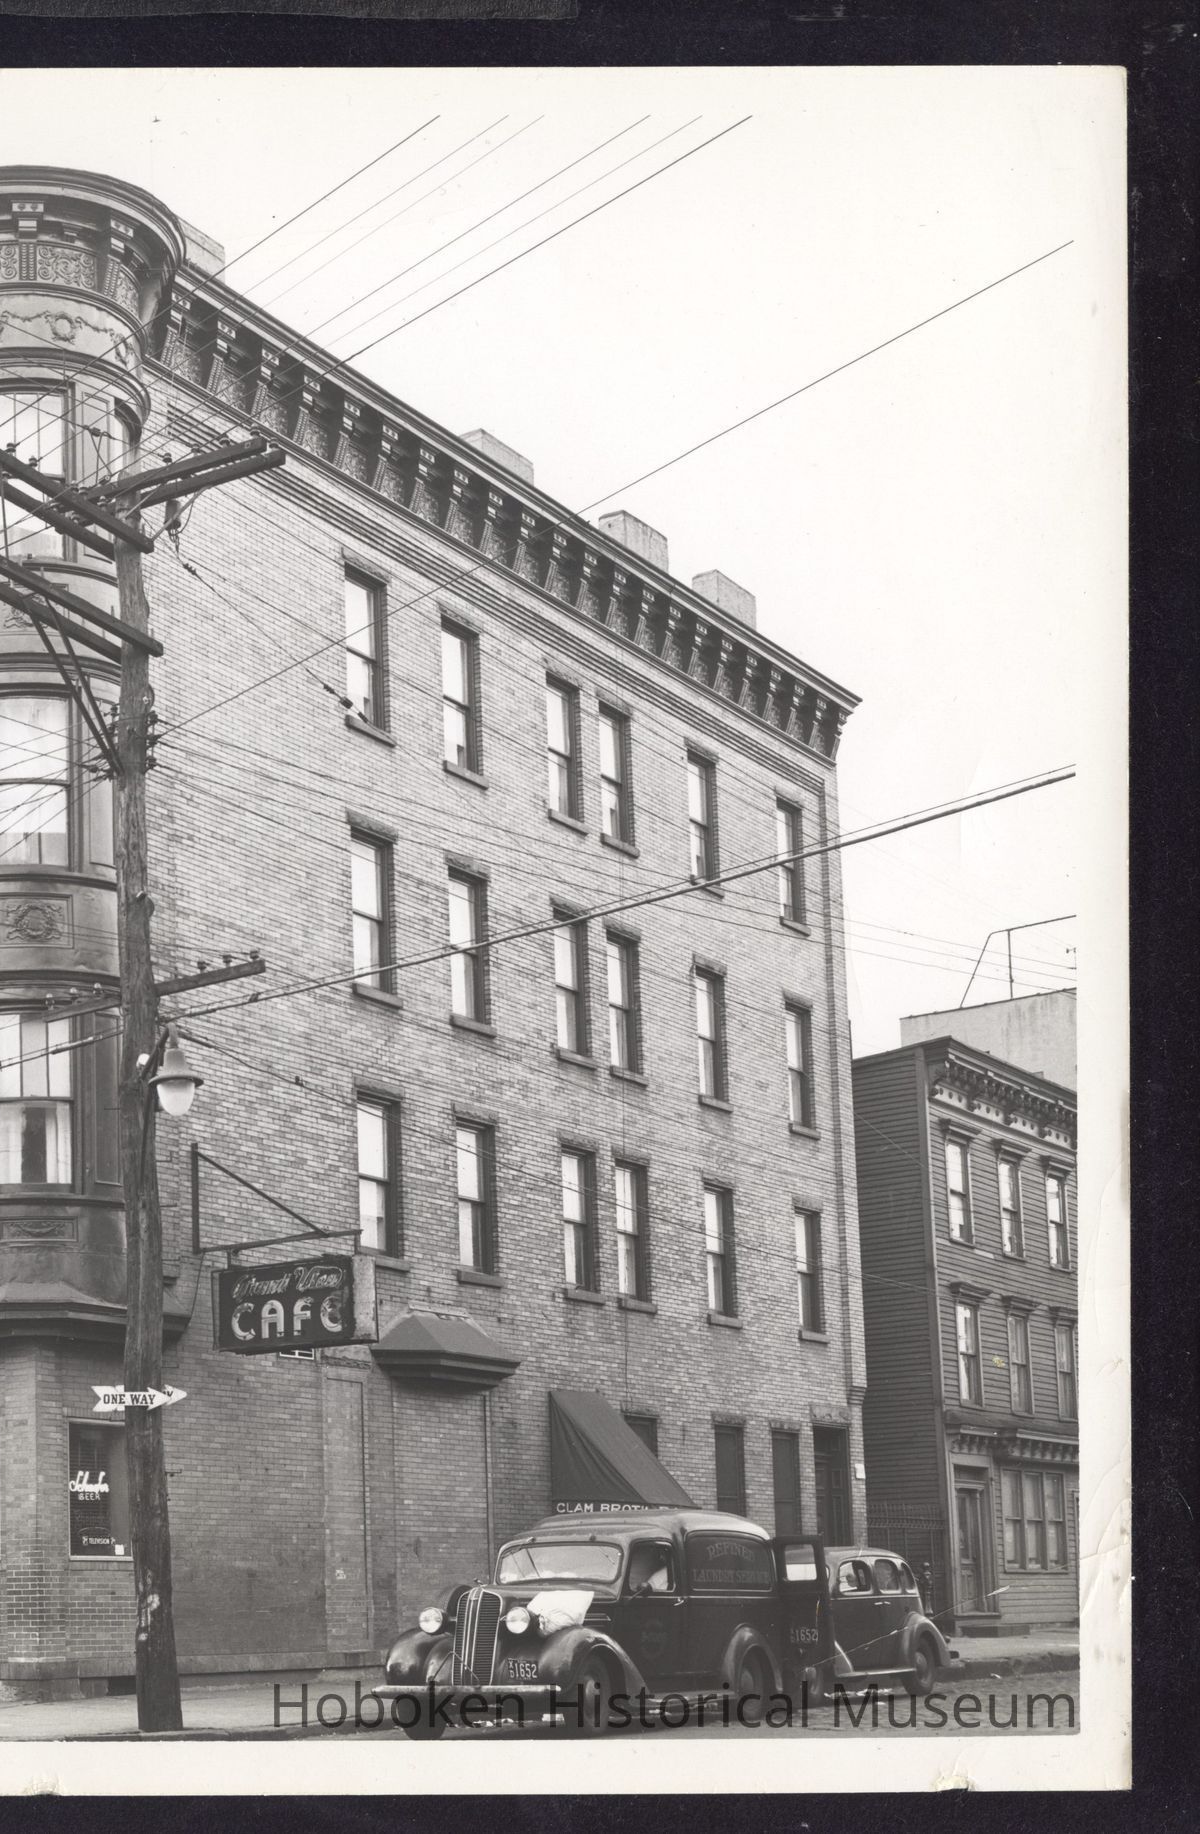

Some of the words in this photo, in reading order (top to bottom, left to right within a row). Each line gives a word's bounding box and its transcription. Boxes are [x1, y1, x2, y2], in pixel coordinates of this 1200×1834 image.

[231, 1295, 343, 1341] CAFE
[103, 1394, 126, 1404] ONE
[130, 1394, 156, 1405] WAY
[78, 1493, 100, 1501] BEER
[556, 1502, 594, 1513] CLAM
[515, 1663, 538, 1678] 1652
